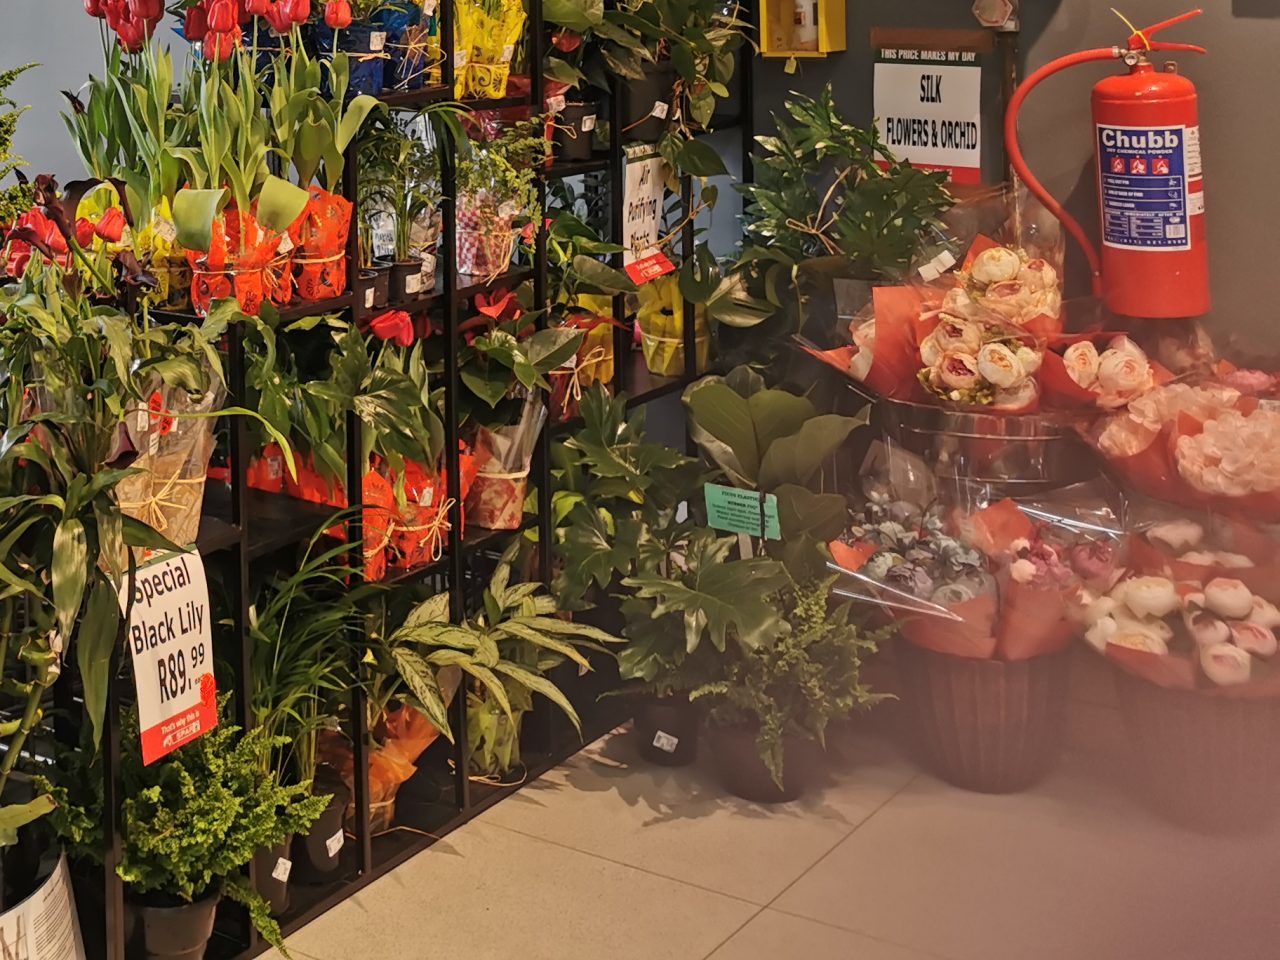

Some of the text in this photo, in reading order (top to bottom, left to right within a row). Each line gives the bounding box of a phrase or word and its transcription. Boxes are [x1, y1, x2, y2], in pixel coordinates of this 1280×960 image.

[881, 48, 976, 62] THIS PRICE MAKES MY DAY
[920, 74, 942, 103] SILK
[886, 117, 977, 150] FLOWERS & ORCHID
[1102, 129, 1179, 148] Chubb
[639, 164, 650, 187] Air
[627, 196, 657, 224] Purifying
[134, 556, 191, 608] Special
[132, 600, 204, 656] Black Lily
